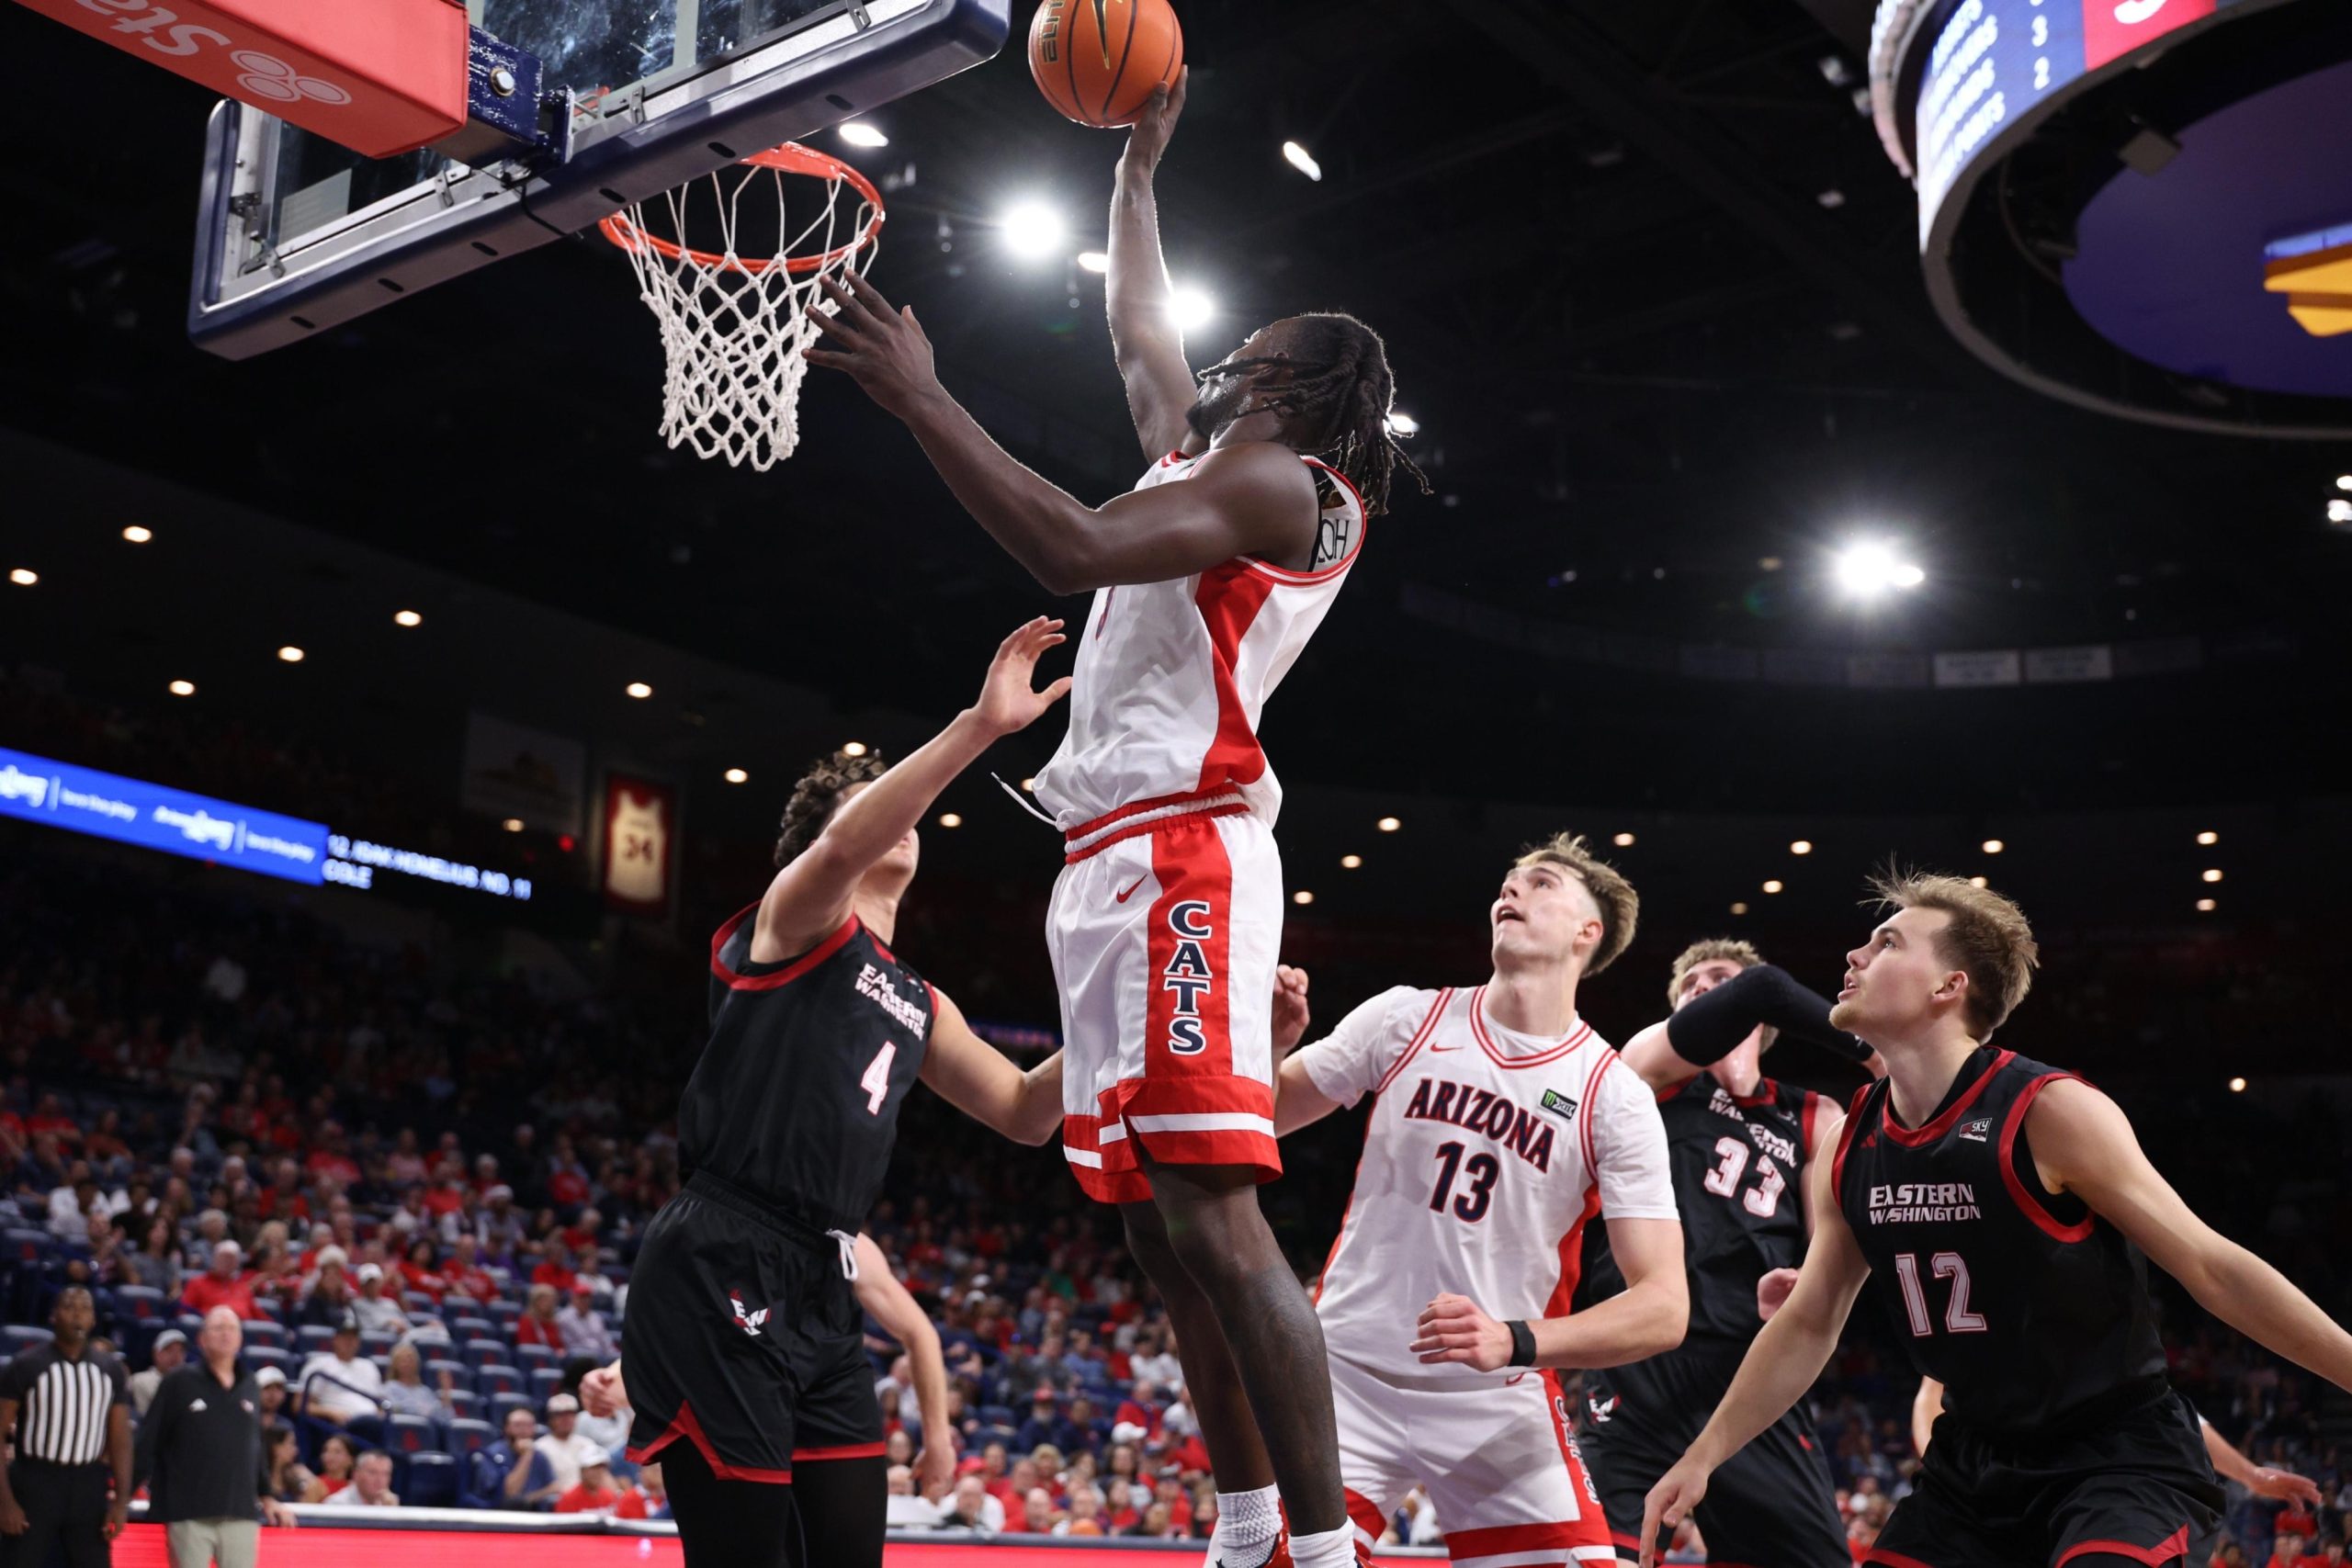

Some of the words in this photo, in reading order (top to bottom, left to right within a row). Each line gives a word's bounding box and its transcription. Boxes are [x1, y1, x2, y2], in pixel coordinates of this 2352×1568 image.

[2031, 15, 2048, 47] 3
[1163, 899, 1213, 1055] CATS
[860, 1040, 897, 1116] 4
[1403, 1077, 1555, 1175] ARIZONA
[1971, 1120, 1990, 1132] SKY
[1429, 1140, 1499, 1224] 13
[1703, 1136, 1786, 1218] 33
[1870, 1183, 1974, 1208] EASTERN
[1870, 1204, 1981, 1225] WASHINGTON
[1895, 1252, 1987, 1337] 12
